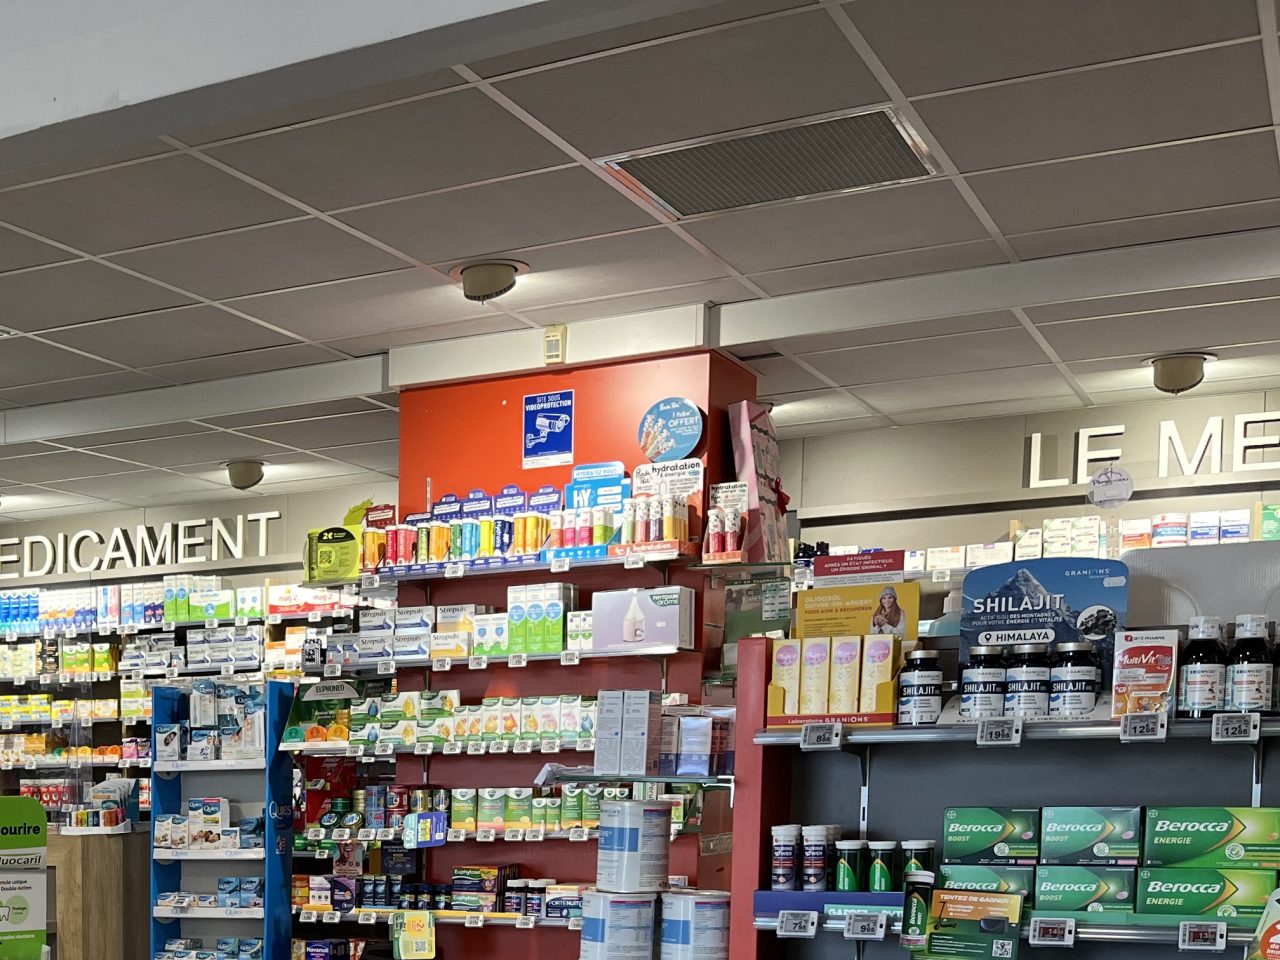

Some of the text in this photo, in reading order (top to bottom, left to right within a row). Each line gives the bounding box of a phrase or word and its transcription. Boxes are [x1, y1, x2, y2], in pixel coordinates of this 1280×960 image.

[526, 400, 572, 411] VIDEOPROTECTION
[668, 416, 699, 428] OFFERT
[1028, 411, 1280, 489] LE ME
[652, 461, 700, 474] hydratation
[573, 490, 591, 508] HY
[973, 594, 1064, 614] SHILAJIT
[1006, 617, 1030, 625] ÉNERGIE
[996, 631, 1050, 642] HIMALAYA
[902, 686, 936, 696] SHILAJIT
[1053, 682, 1085, 691] SHILAJIT
[825, 715, 869, 724] GRANIONS
[269, 800, 293, 820] Quies
[948, 823, 1004, 833] Berocca
[1154, 820, 1231, 833] Berocca
[1154, 836, 1192, 845] ENERGIE
